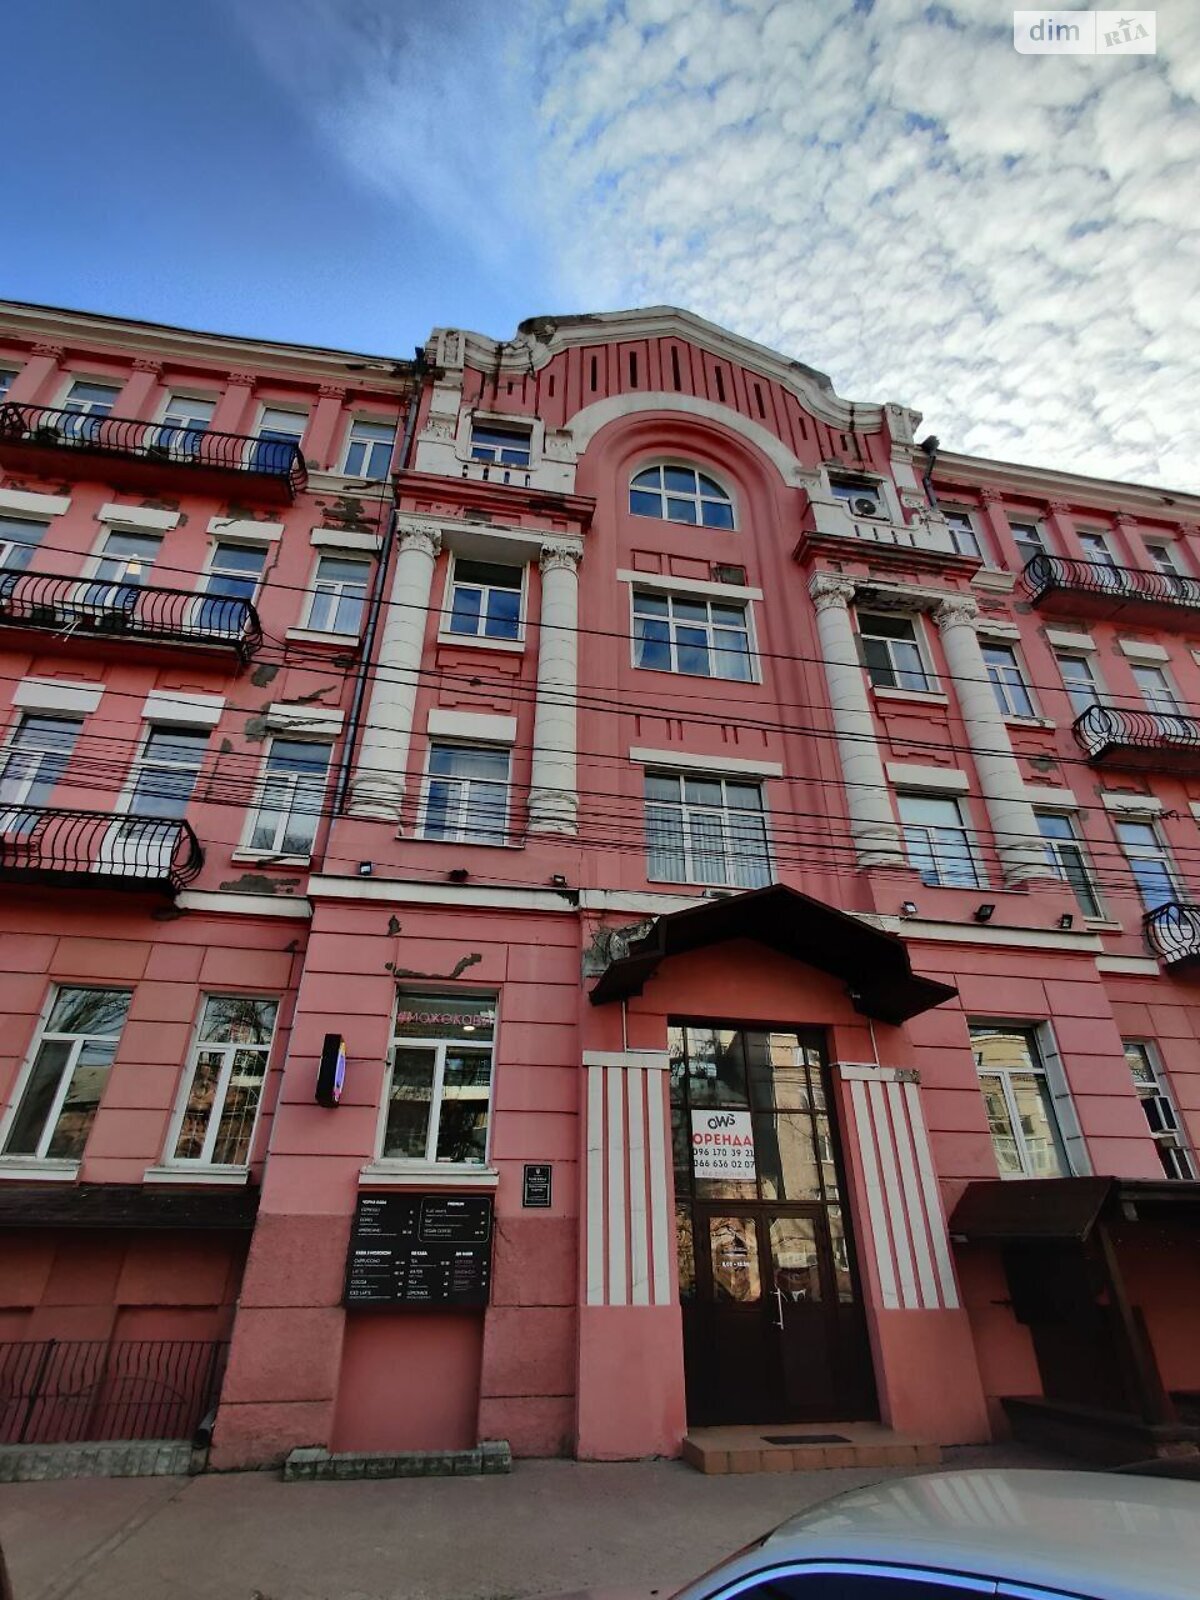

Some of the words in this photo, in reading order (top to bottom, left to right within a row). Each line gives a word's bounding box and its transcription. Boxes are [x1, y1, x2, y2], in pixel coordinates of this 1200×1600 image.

[693, 1132, 752, 1147] ОРЕНДА
[713, 1148, 727, 1156] 170
[731, 1149, 741, 1157] 39
[713, 1160, 729, 1168] 636
[731, 1160, 742, 1168] 02
